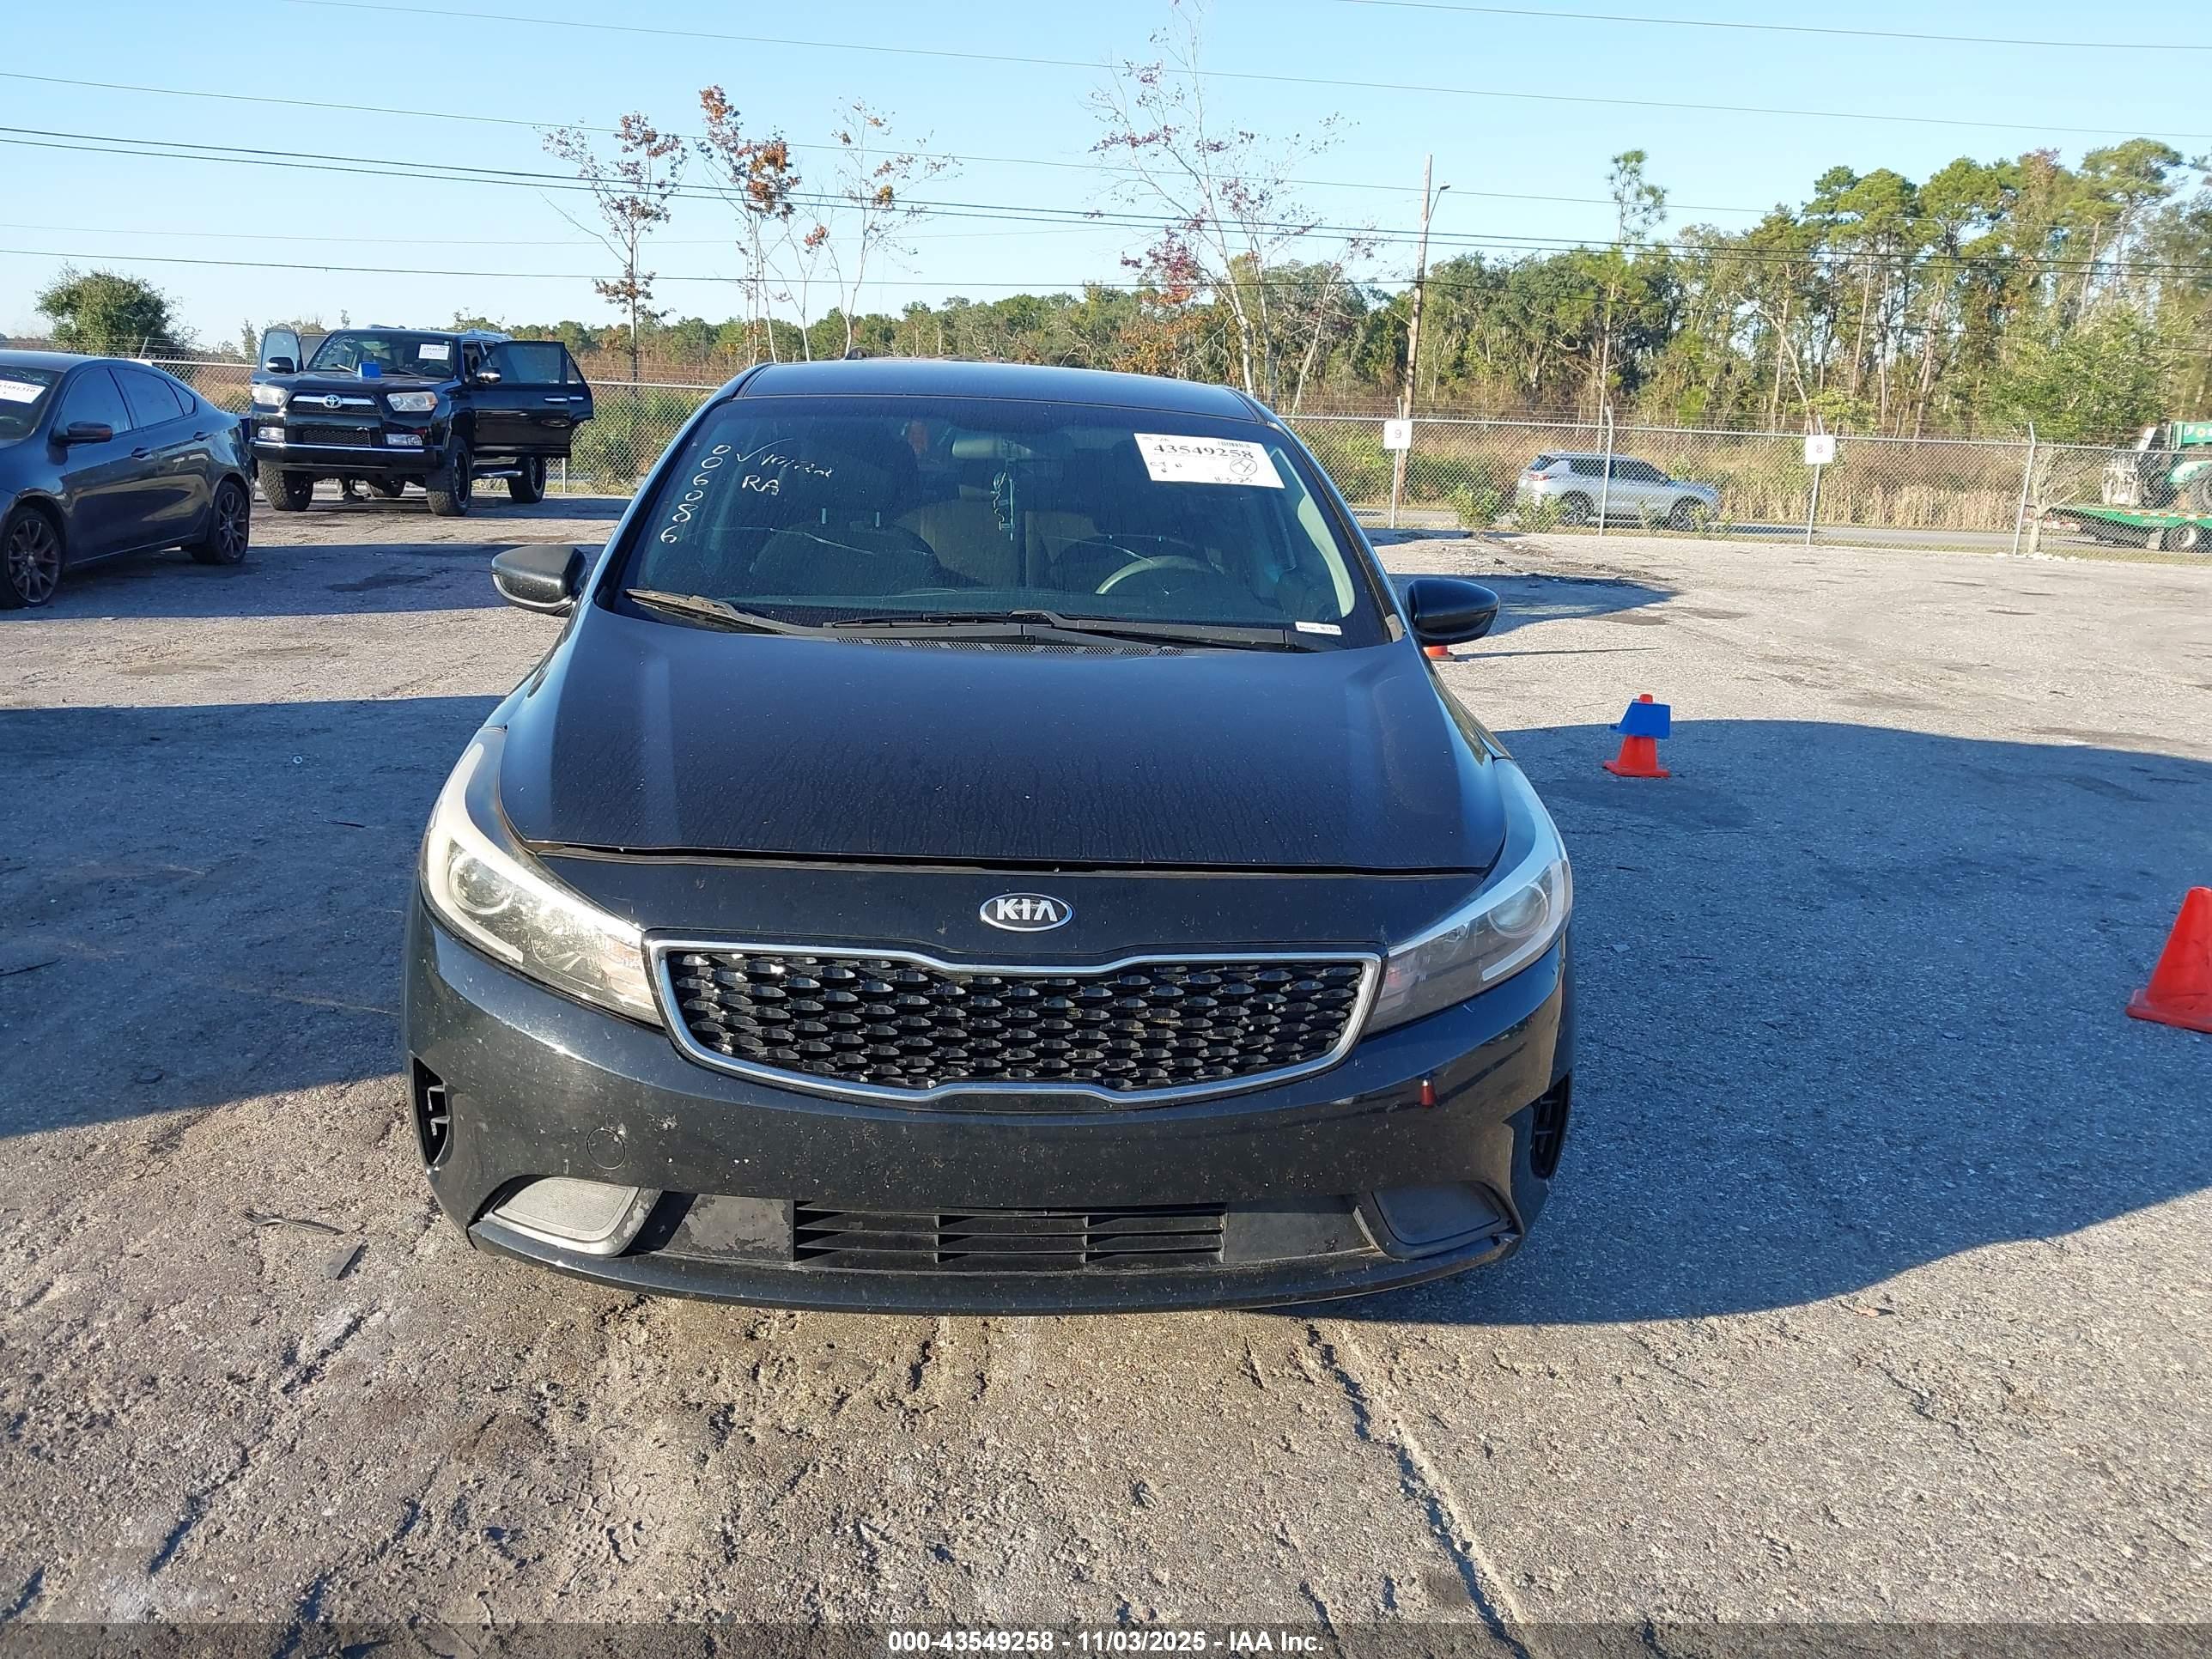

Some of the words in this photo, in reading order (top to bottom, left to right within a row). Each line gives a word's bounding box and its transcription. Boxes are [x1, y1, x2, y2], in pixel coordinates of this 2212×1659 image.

[1395, 428, 1402, 439] 9
[1153, 444, 1255, 459] 43549258
[1816, 444, 1824, 453] 8
[996, 898, 1058, 922] KIA
